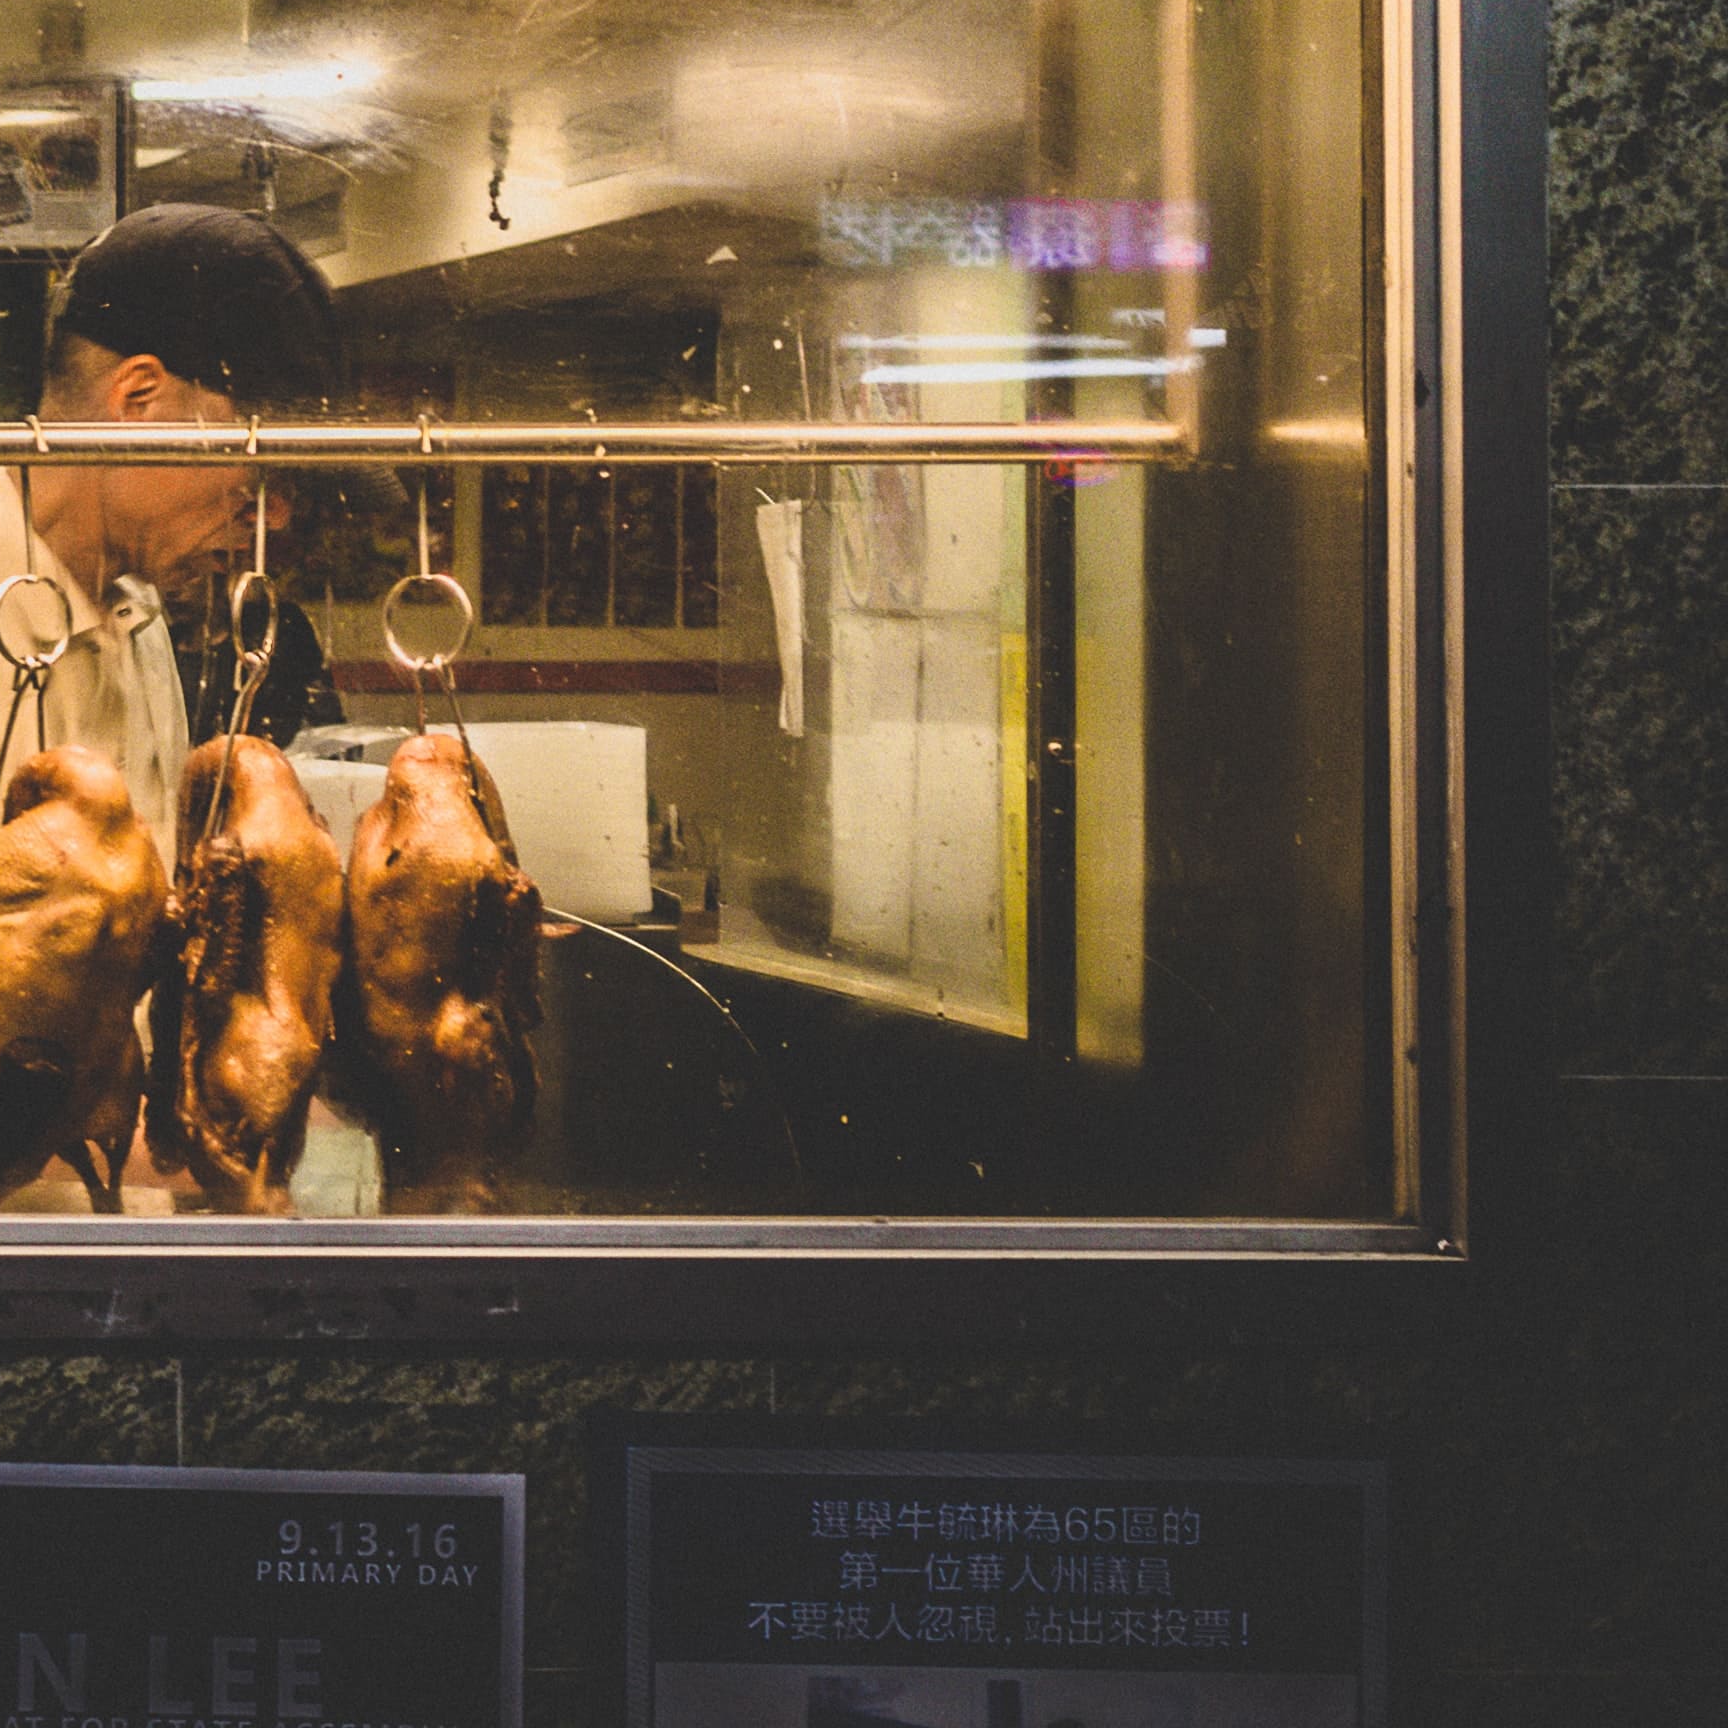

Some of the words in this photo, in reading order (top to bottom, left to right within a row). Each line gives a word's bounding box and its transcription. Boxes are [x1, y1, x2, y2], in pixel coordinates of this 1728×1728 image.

[279, 1519, 458, 1559] 9.13.16
[810, 1499, 1200, 1545] 選舉牛毓琳為65區的
[256, 1559, 401, 1584] PRIMARY
[418, 1565, 478, 1585] DAY
[839, 1550, 1175, 1595] 第一位華人州議員
[149, 1635, 324, 1717] LEE
